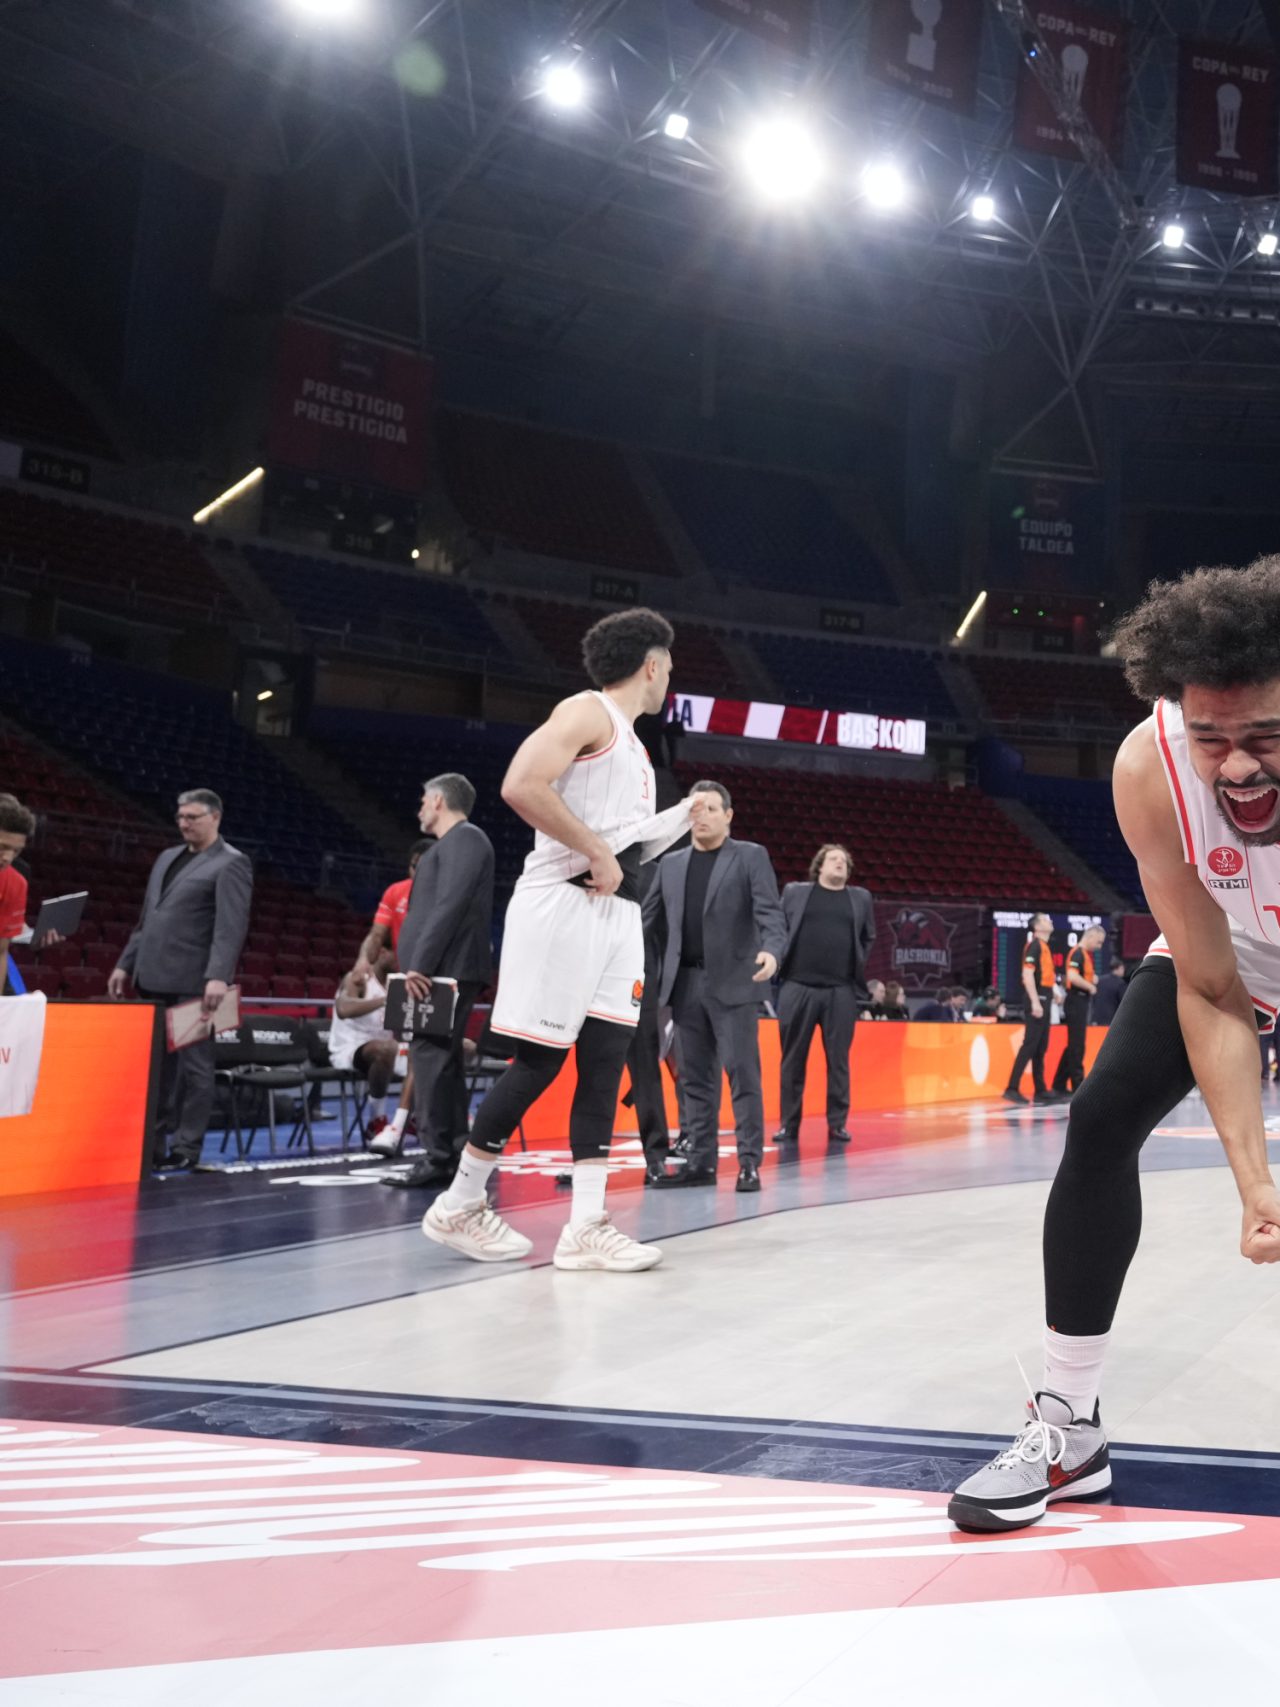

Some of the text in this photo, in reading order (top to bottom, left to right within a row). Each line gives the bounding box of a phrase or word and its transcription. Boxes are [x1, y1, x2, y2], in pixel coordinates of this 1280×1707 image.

[1037, 13, 1075, 37] COPA
[1089, 27, 1117, 47] REY
[1192, 56, 1228, 75] COPA
[1241, 65, 1269, 83] REY
[303, 378, 404, 421] PRESTIGIO
[294, 399, 407, 443] PRESTIGIOA
[1021, 518, 1073, 537] EQUIPO
[1019, 535, 1074, 555] TALDEA
[1210, 879, 1248, 889] RTMI
[540, 1019, 566, 1031] nuvei
